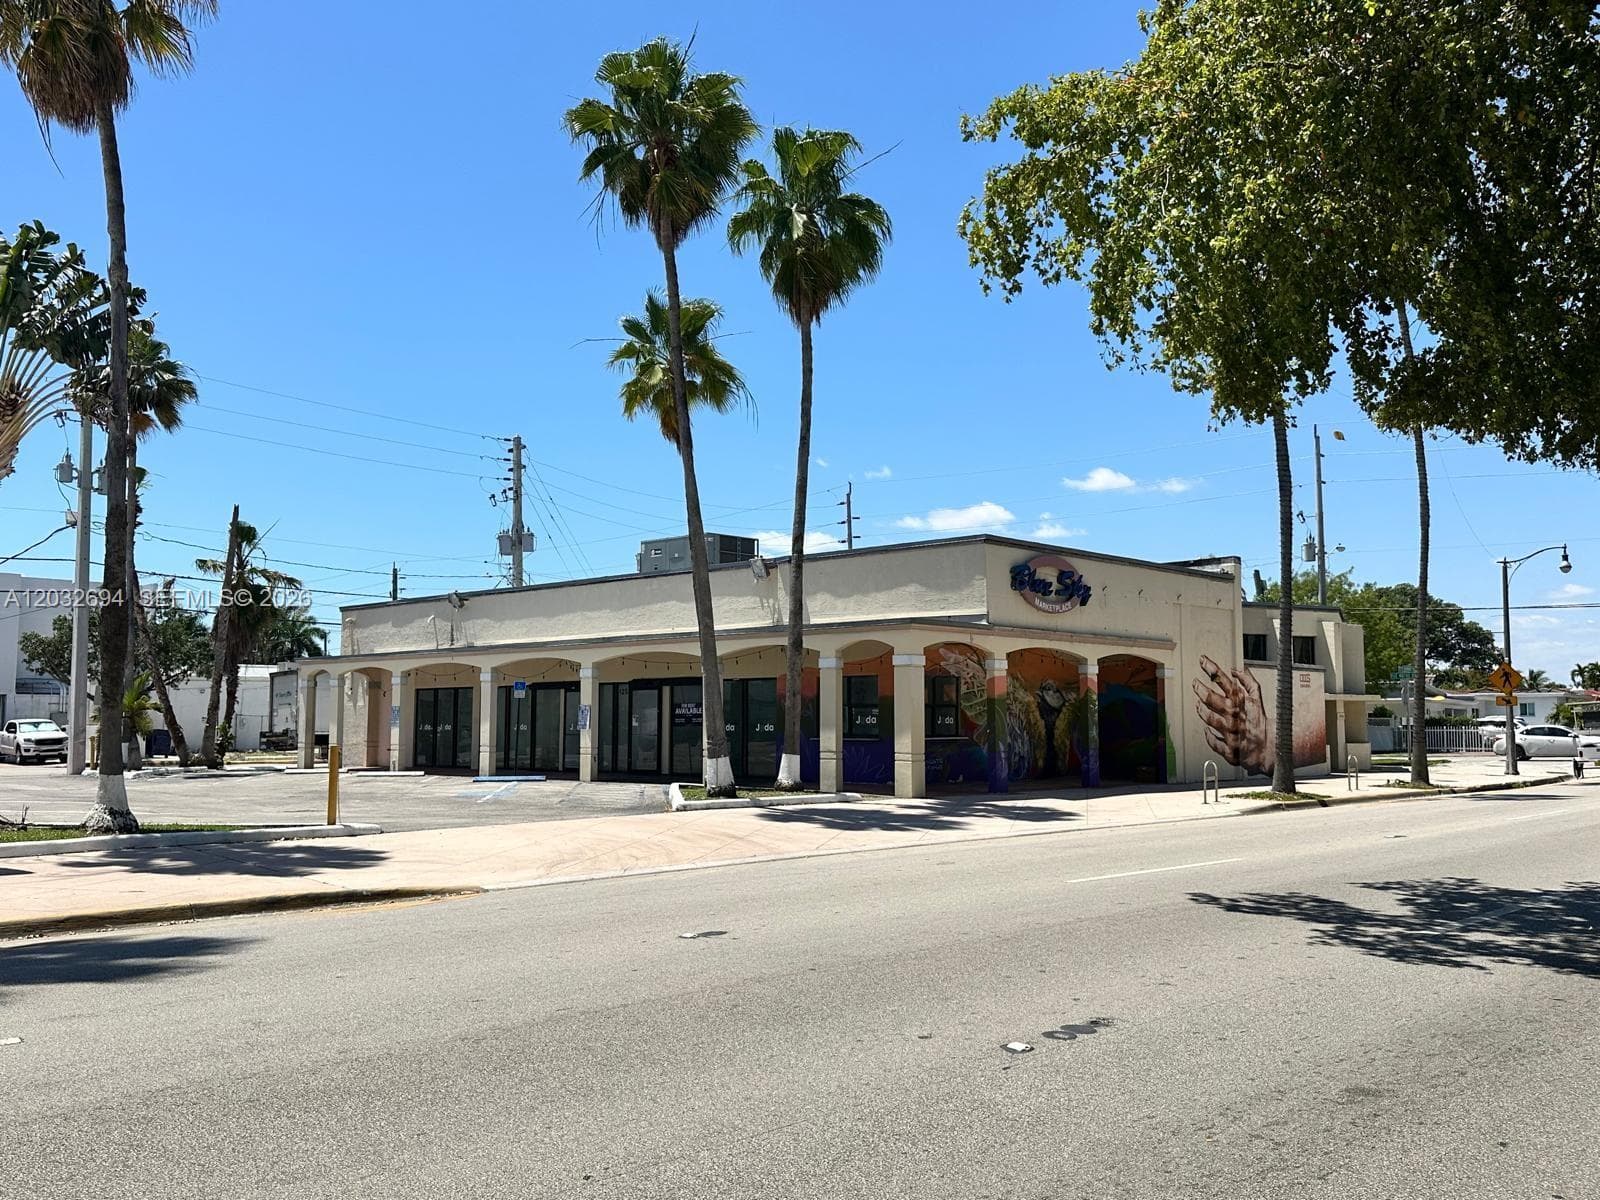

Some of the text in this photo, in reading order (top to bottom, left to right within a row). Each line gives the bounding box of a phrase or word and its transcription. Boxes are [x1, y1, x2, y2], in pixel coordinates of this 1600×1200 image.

[1009, 563, 1092, 606] Blue Sky
[1034, 597, 1073, 613] MARKETPLACE
